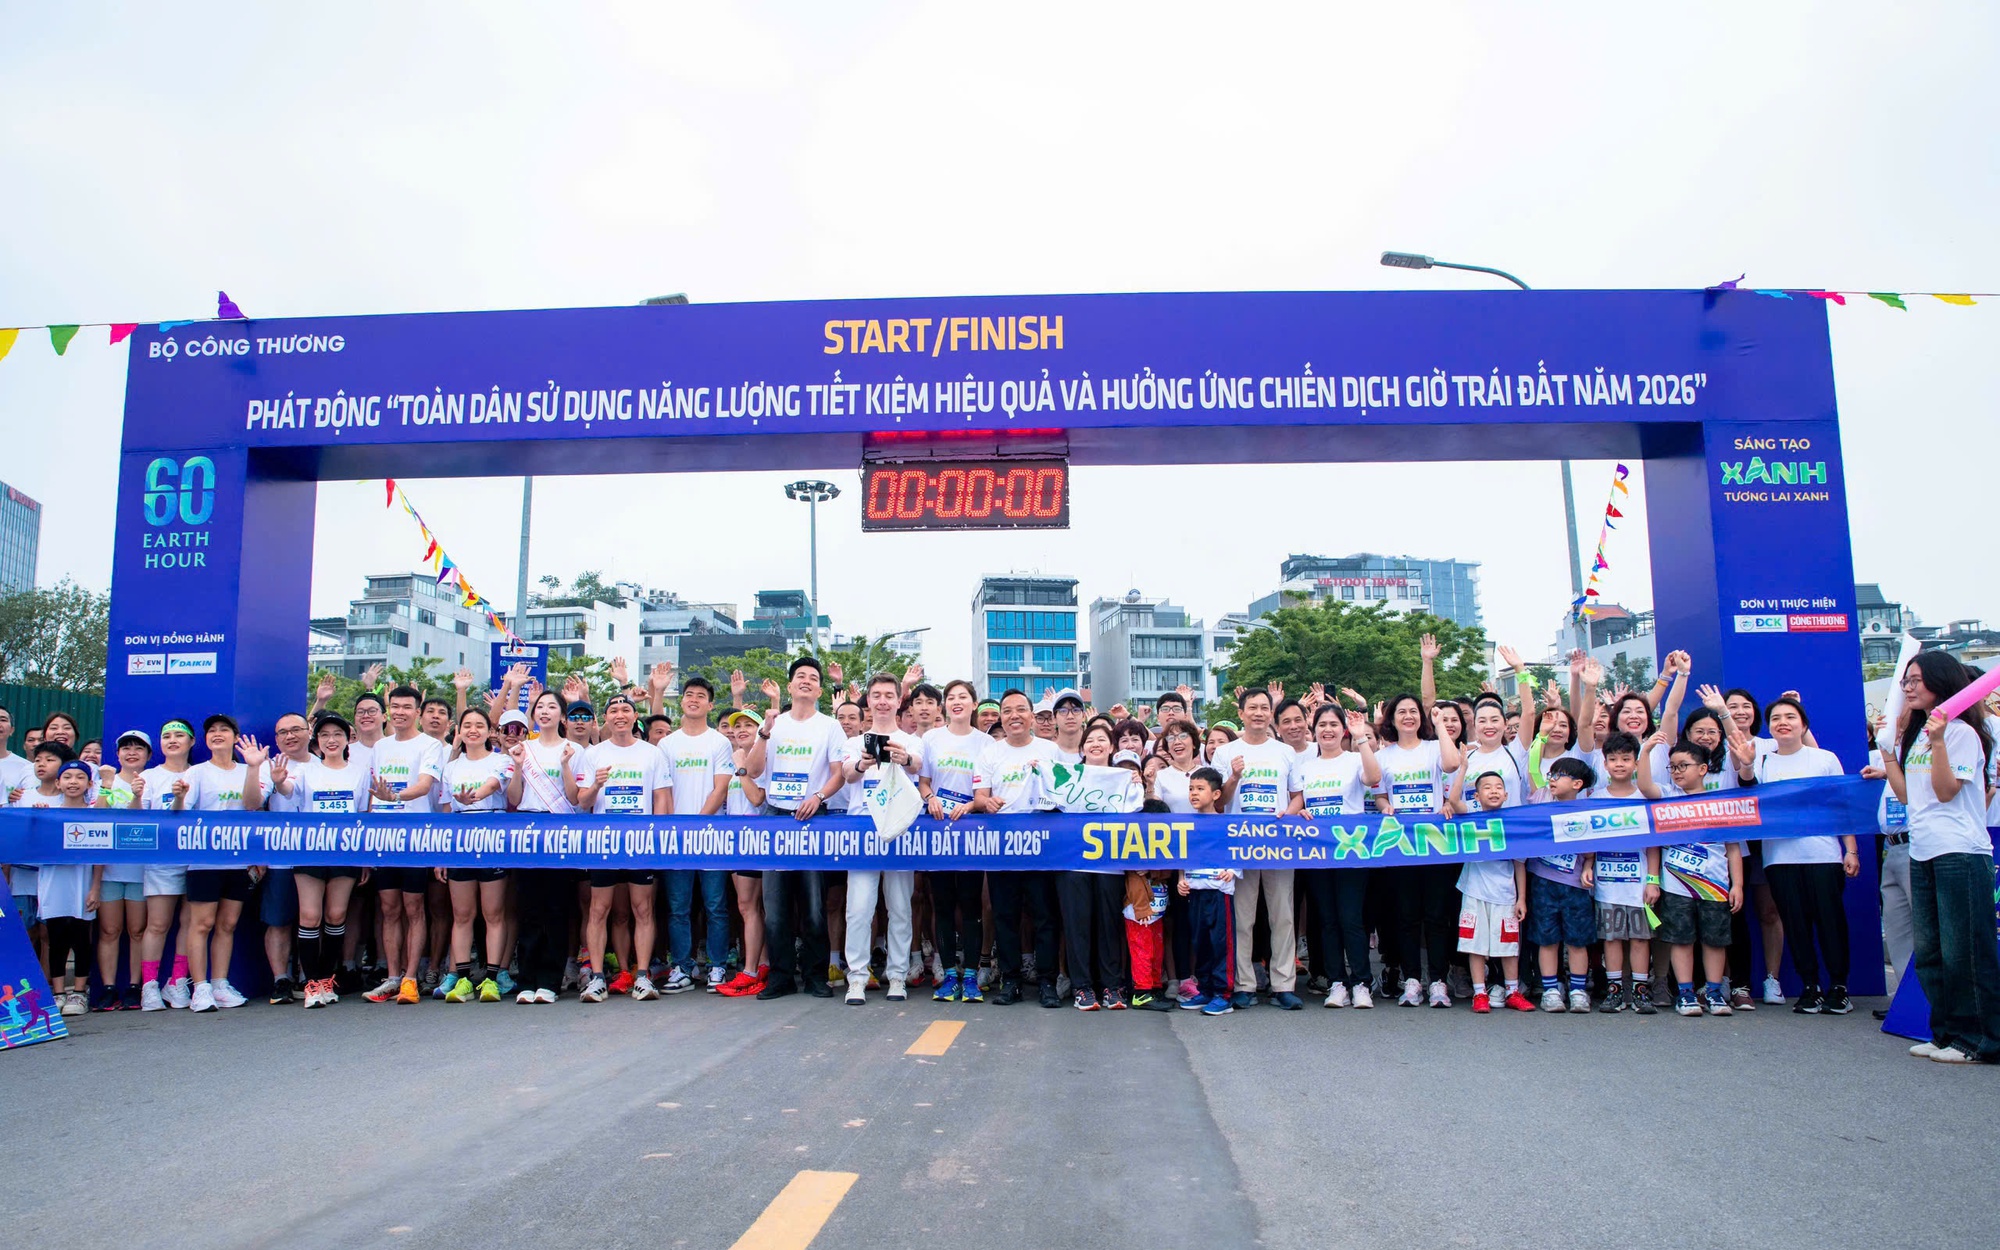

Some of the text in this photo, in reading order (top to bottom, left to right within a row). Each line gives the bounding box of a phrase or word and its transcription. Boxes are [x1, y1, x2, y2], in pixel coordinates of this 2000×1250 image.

[823, 315, 1064, 358] START/FINISH
[149, 334, 345, 362] BỘ CÔNG THƯƠNG
[246, 359, 1707, 436] PHÁT ĐỘNG “TOÀN DÂN SỬ DỤNG NĂNG LƯỢNG TIẾT KIỆM HIỆU QUẢ VÀ HƯỞNG ỨNG CHIẾN DỊCH GIỜ TRÁI ĐẤT NĂM 2026”
[1734, 436, 1810, 453] SÁNG TẠO
[1720, 456, 1827, 484] XANH
[143, 456, 216, 526] 60
[868, 468, 1063, 520] 00:00:00
[1724, 491, 1829, 502] TƯƠNG LAI XANH
[143, 531, 210, 548] EARTH
[145, 552, 207, 569] HOUR
[1372, 578, 1408, 586] TRAVEL
[1740, 596, 1836, 610] ĐƠN VỊ THỰC HIỆN
[1755, 618, 1782, 627] ĐCK
[125, 631, 225, 646] ĐƠN VỊ ĐỒNG HÀNH
[1905, 754, 1932, 765] ANH
[777, 783, 802, 792] 3.663
[320, 801, 347, 809] 3.453
[612, 796, 638, 804] 3.259
[1243, 794, 1275, 803] 28.403
[1400, 794, 1427, 803] 3.668
[1310, 807, 1341, 816] 28.402
[1590, 811, 1639, 829] ĐCK
[88, 830, 108, 838] EVN
[1227, 820, 1319, 841] SÁNG TẠO
[1331, 816, 1507, 860] XANH
[177, 818, 207, 851] GIẢI
[211, 826, 251, 856] CHẠY
[306, 822, 338, 851] DÂN
[340, 820, 364, 852] SỬ
[365, 828, 405, 857] DỤNG
[410, 824, 453, 852] NĂNG
[456, 827, 505, 858] LƯỢNG
[510, 822, 540, 854] TIẾT
[543, 825, 581, 859] KIỆM
[586, 825, 620, 859] HIỆU
[624, 823, 654, 857] QUẢ
[659, 826, 679, 855] VÀ
[683, 823, 734, 856] HƯỞNG
[738, 826, 773, 856] ỨNG
[774, 823, 820, 856] CHIẾN
[824, 830, 859, 861] DỊCH
[931, 823, 960, 856] ĐẤT
[965, 825, 1000, 856] NĂM
[1004, 830, 1050, 856] 2026"
[1082, 822, 1194, 860] START
[1228, 846, 1326, 860] TƯƠNG LAI
[1669, 850, 1703, 867] 21.657
[1601, 863, 1637, 873] 21.560
